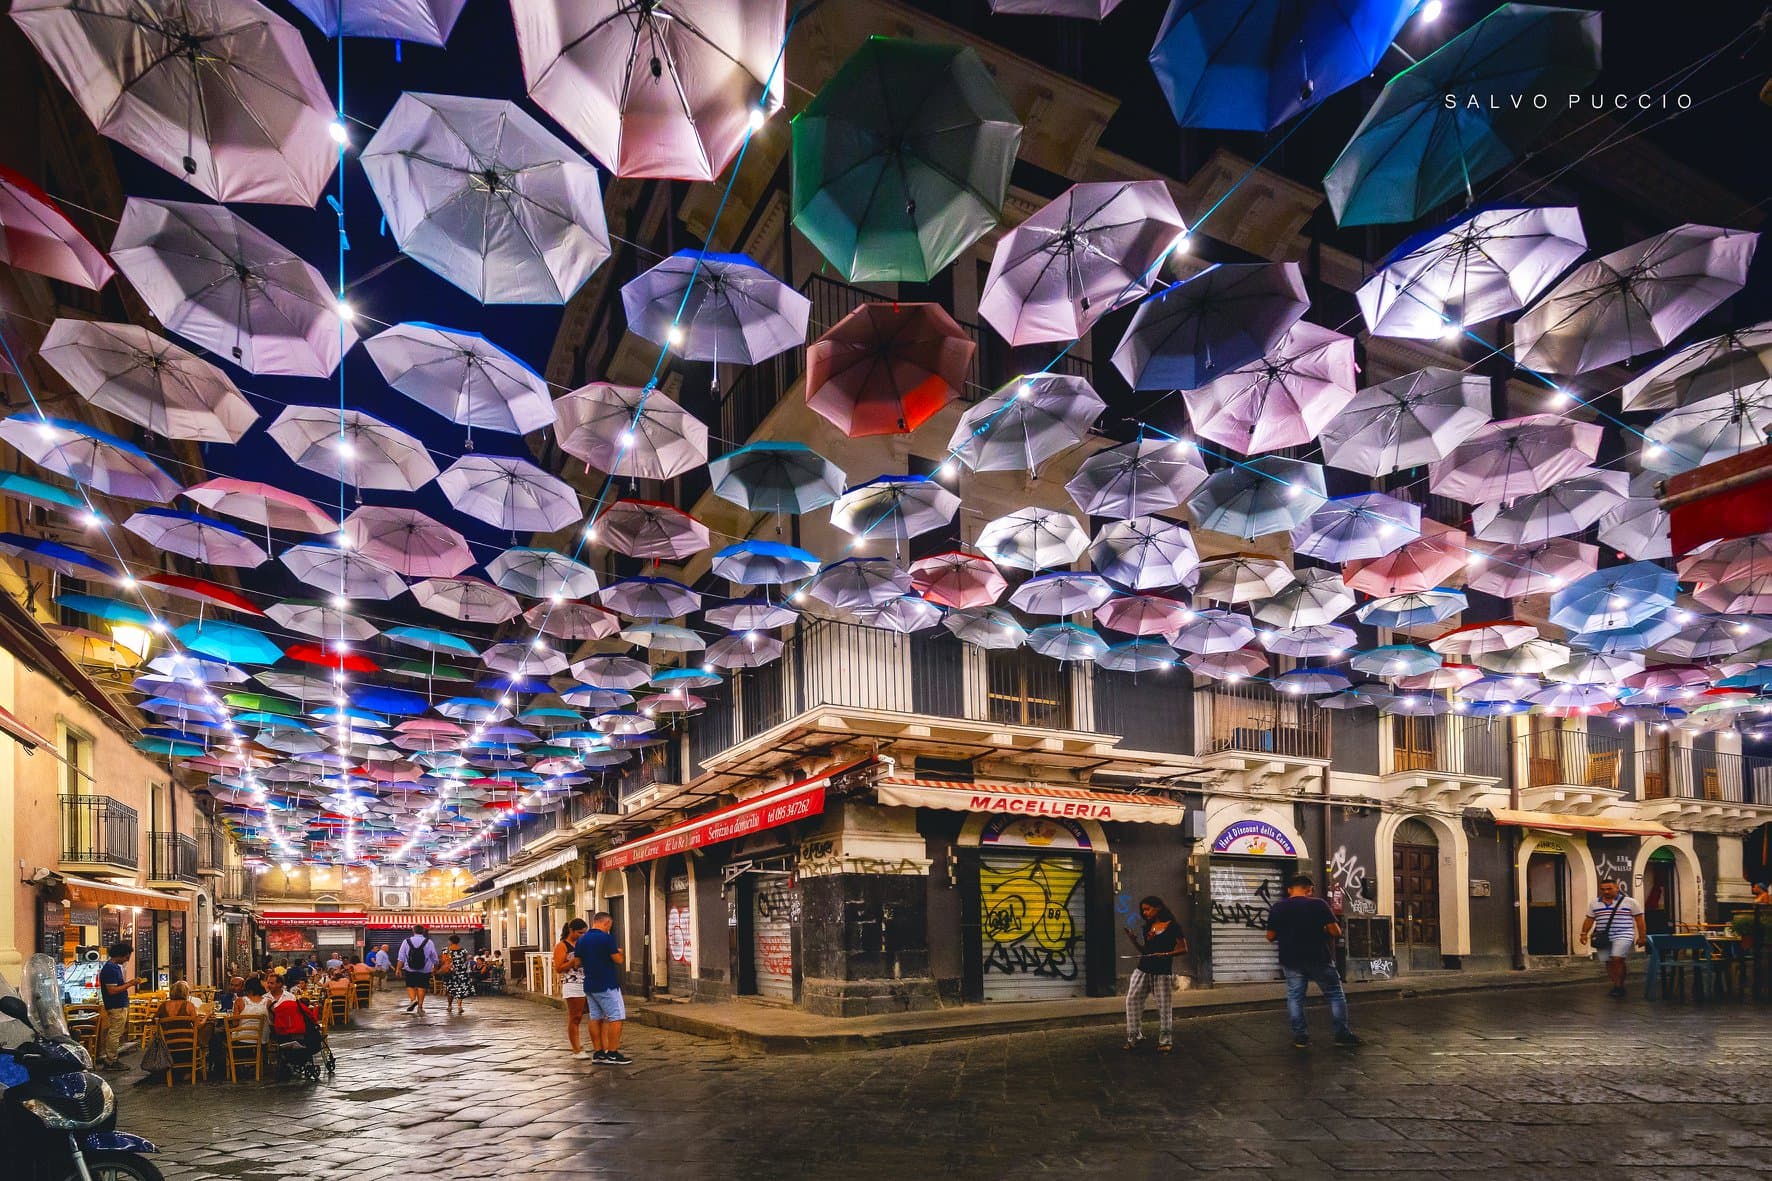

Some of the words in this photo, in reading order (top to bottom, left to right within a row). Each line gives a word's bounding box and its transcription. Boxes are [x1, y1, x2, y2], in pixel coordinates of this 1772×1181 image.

[733, 812, 760, 833] domicilio
[786, 799, 810, 818] 347262
[969, 796, 1112, 818] MACELLERIA
[1218, 831, 1234, 849] Hard
[1232, 825, 1259, 837] Discount
[1260, 825, 1275, 838] della
[1276, 833, 1291, 852] Carne
